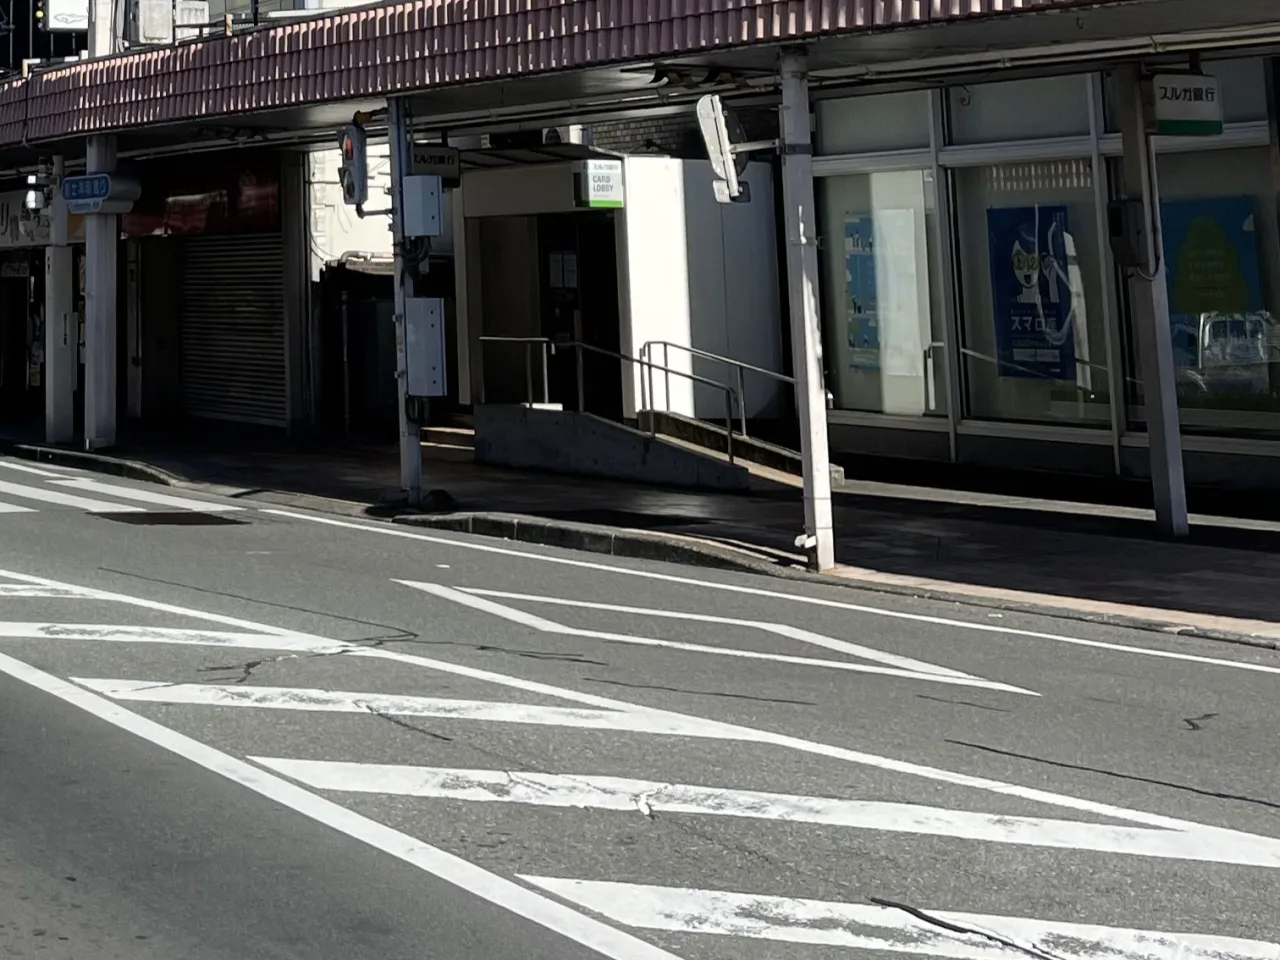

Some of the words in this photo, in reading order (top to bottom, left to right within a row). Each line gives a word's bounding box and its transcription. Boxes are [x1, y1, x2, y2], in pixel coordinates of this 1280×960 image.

[1159, 86, 1216, 102] スルガ銀行
[592, 175, 611, 183] CARD
